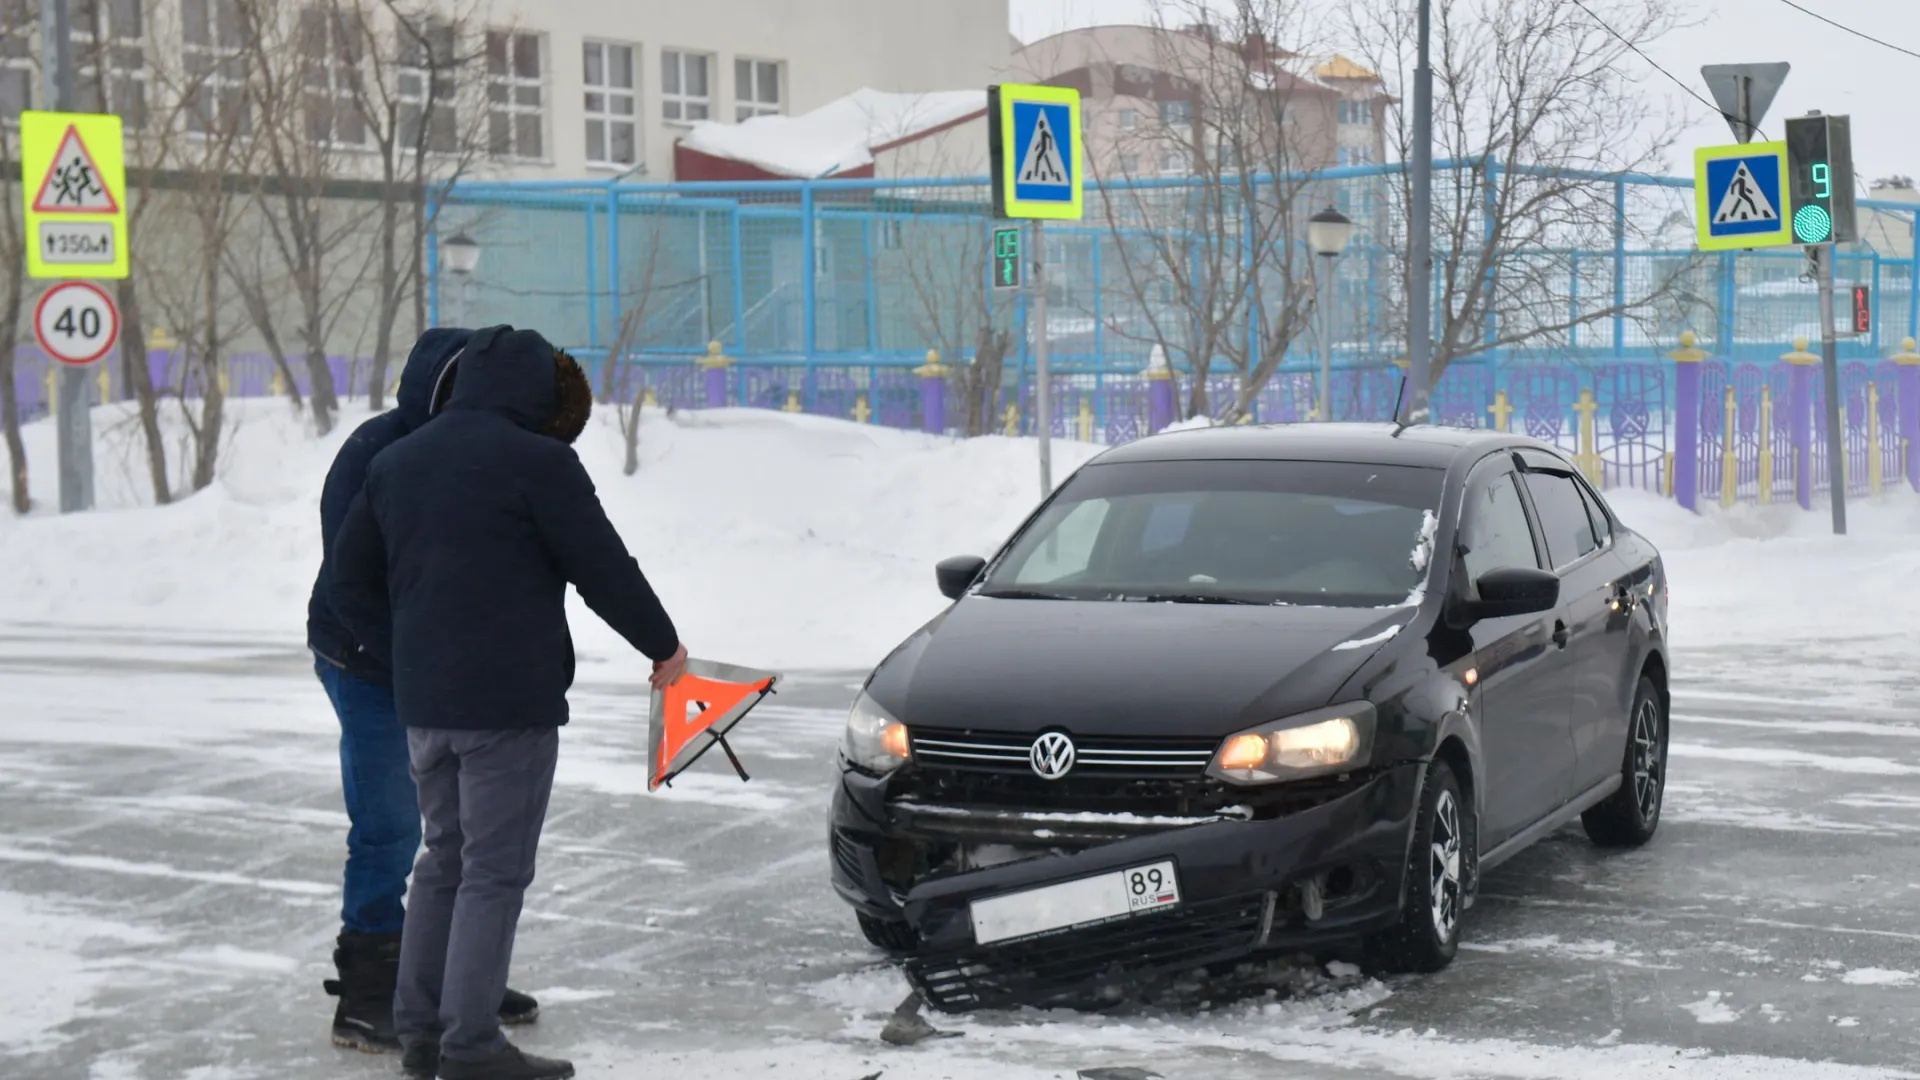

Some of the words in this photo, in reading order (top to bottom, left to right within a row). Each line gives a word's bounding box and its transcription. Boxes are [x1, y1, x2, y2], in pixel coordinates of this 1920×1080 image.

[1812, 163, 1831, 198] 9
[53, 306, 101, 339] 40
[1131, 868, 1162, 895] 89
[1132, 894, 1156, 906] RUS
